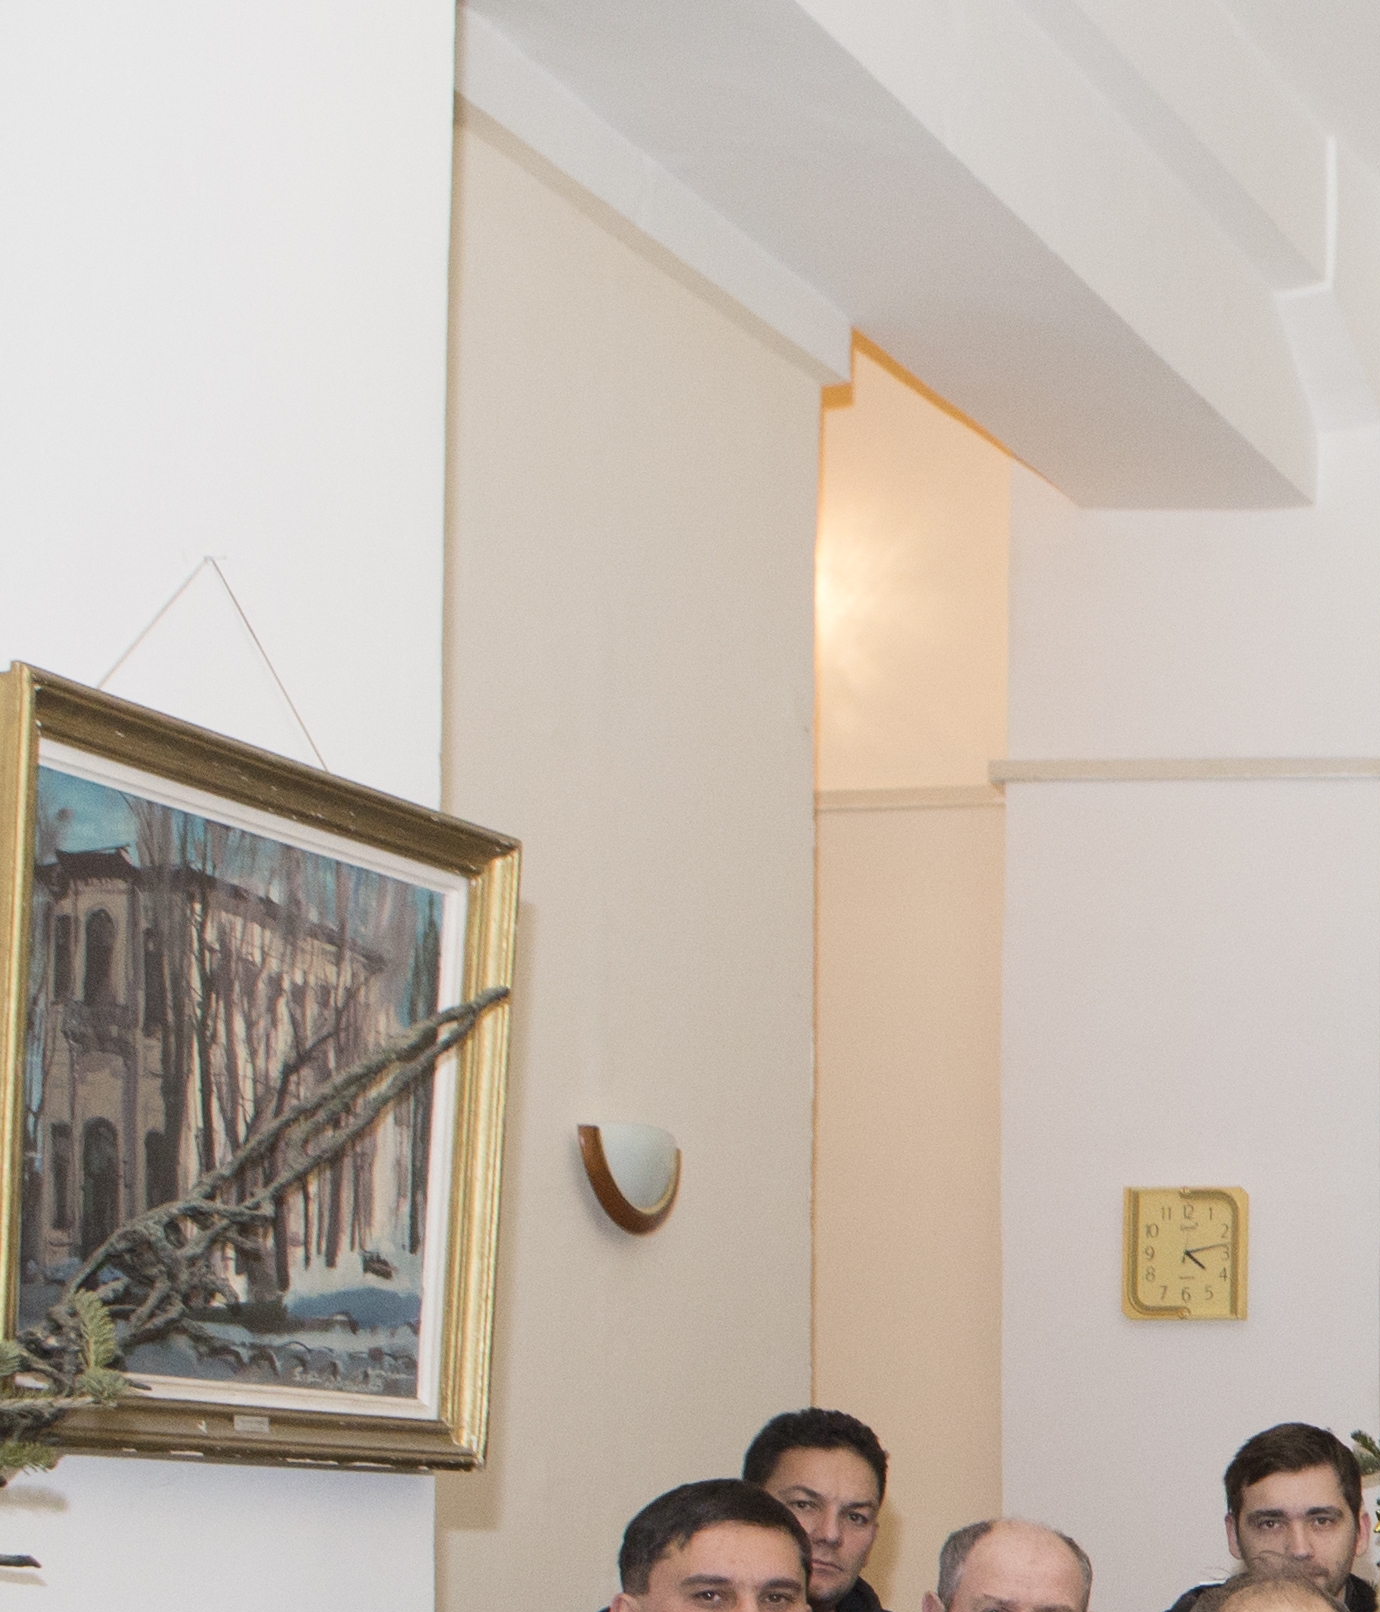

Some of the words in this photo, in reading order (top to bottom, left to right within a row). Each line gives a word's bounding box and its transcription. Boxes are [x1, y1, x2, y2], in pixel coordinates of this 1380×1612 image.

[1161, 1206, 1172, 1220] 11
[1183, 1204, 1194, 1219] 12
[1145, 1223, 1159, 1238] 10
[1221, 1223, 1228, 1238] 2
[1145, 1245, 1155, 1260] 9
[1220, 1244, 1229, 1261] 3
[1145, 1266, 1156, 1281] 8
[1219, 1267, 1227, 1281] 4
[1160, 1285, 1168, 1300] 7
[1181, 1287, 1191, 1304] 6
[1205, 1285, 1214, 1300] 5
